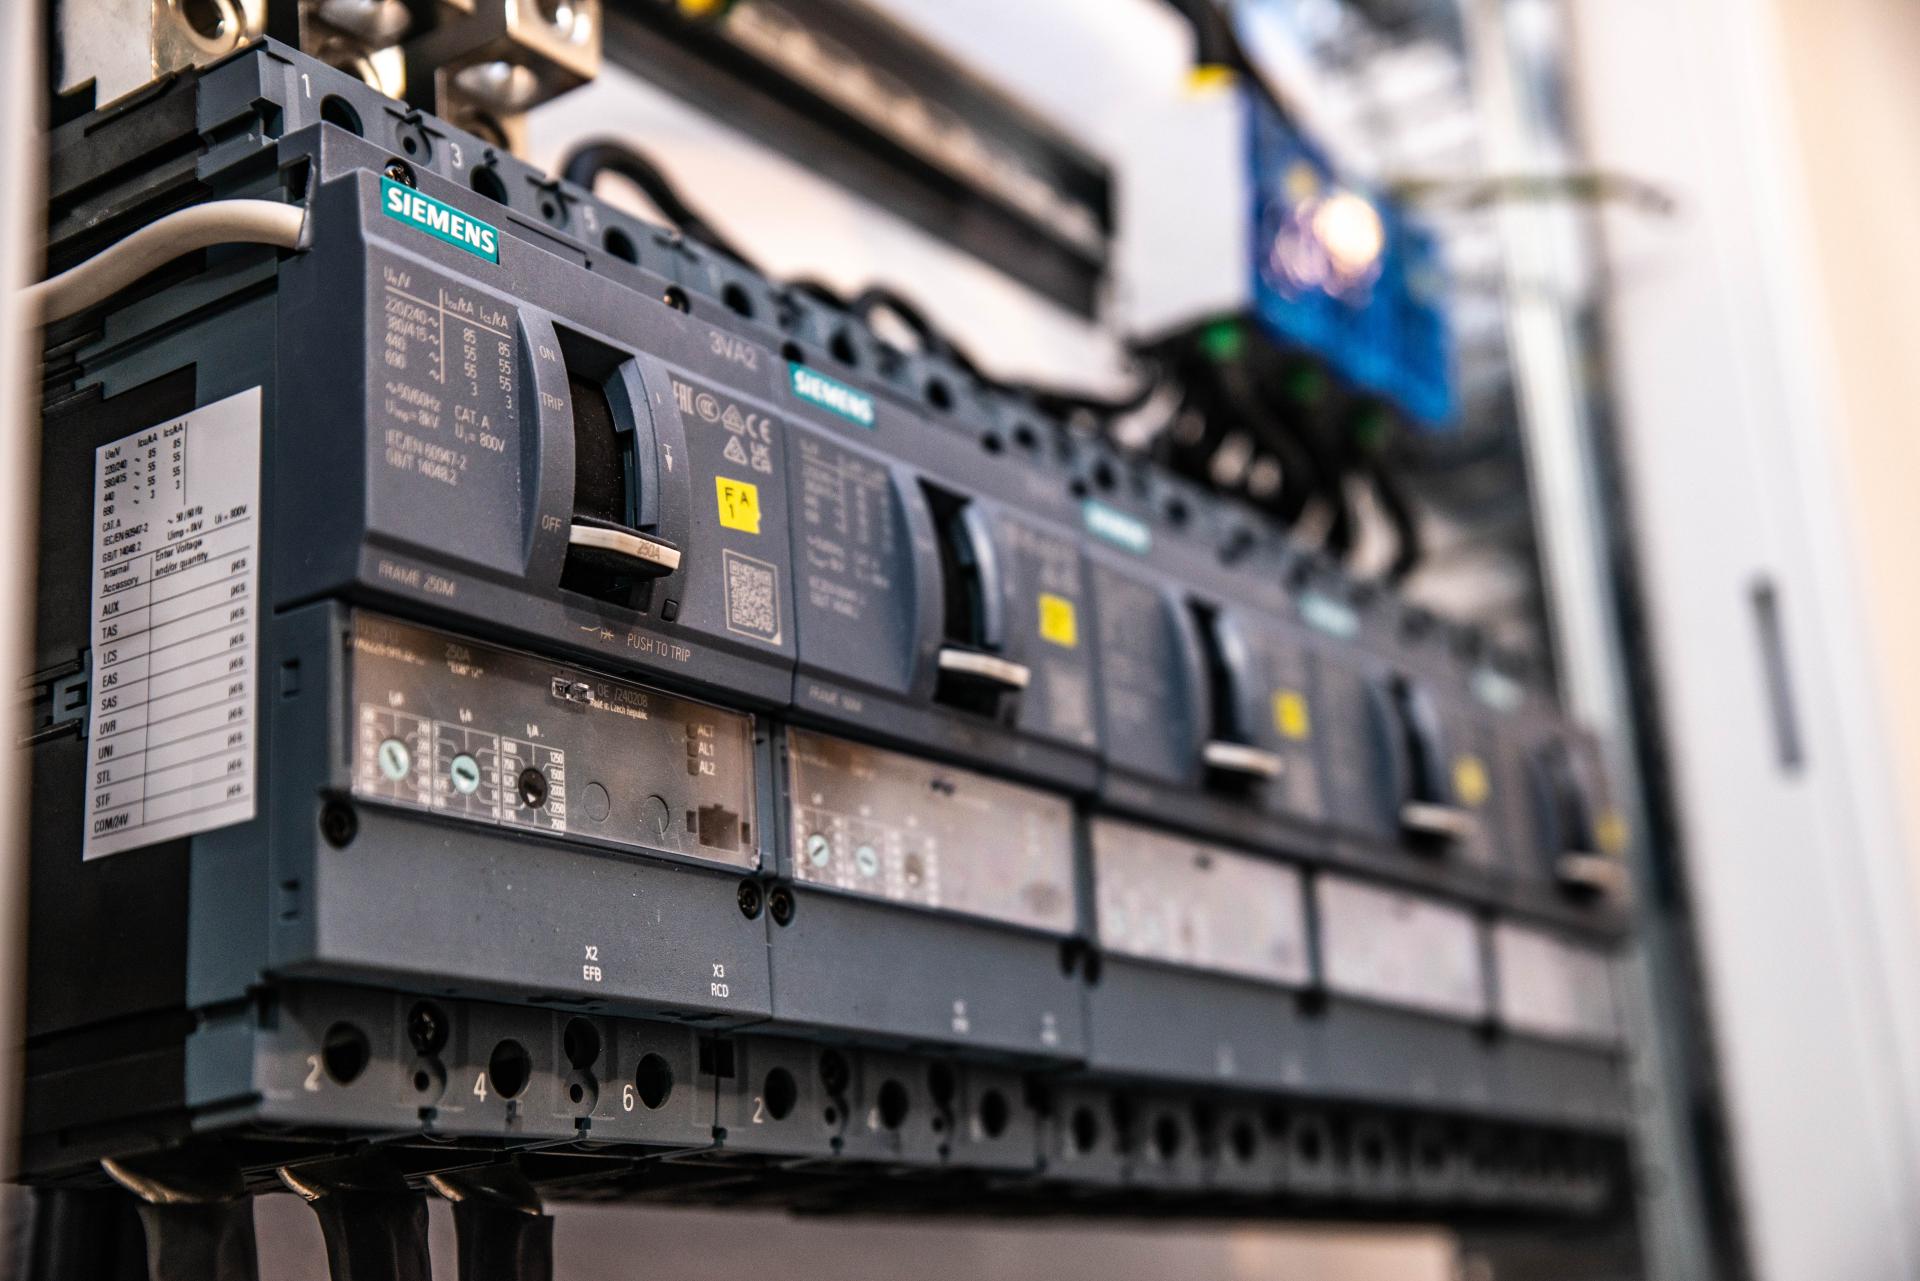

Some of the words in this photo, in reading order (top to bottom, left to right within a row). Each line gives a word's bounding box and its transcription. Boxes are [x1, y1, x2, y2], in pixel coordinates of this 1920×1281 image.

[450, 143, 465, 168] 3
[387, 186, 495, 254] SIEMENS
[463, 345, 477, 362] 55
[498, 358, 512, 375] 55
[538, 344, 556, 362] ON
[464, 362, 478, 379] 55
[498, 375, 512, 393] 55
[470, 381, 478, 397] 3
[505, 395, 512, 410] 3
[540, 391, 564, 412] TRIP
[454, 405, 479, 427] CAT.
[481, 415, 490, 431] A
[479, 432, 506, 453] 800V
[541, 516, 562, 531] OFF
[103, 562, 130, 580] Internal
[155, 548, 174, 562] Enter
[175, 538, 203, 555] Voltage
[103, 576, 139, 593] Accessory
[154, 562, 178, 577] and/or
[179, 551, 209, 571] quantity
[102, 600, 119, 618] AUX
[102, 624, 118, 640] TAS
[103, 649, 117, 665] LCS
[627, 632, 653, 653] PUSH
[655, 640, 669, 658] TO
[670, 645, 691, 663] TRIP
[102, 672, 118, 688] EAS
[101, 695, 117, 711] SAS
[100, 720, 117, 735] UVR
[698, 742, 714, 757] AL1
[96, 769, 111, 785] STL
[699, 762, 716, 776] AL2
[95, 792, 111, 809] STF
[93, 812, 129, 834] COM/24V
[585, 945, 599, 962] X2
[583, 965, 602, 982] EFB
[712, 963, 725, 978] X3
[710, 982, 729, 998] RCD
[304, 1055, 322, 1092] 2
[473, 1072, 488, 1103] 4
[622, 1084, 634, 1112] 6
[752, 1096, 764, 1124] 2
